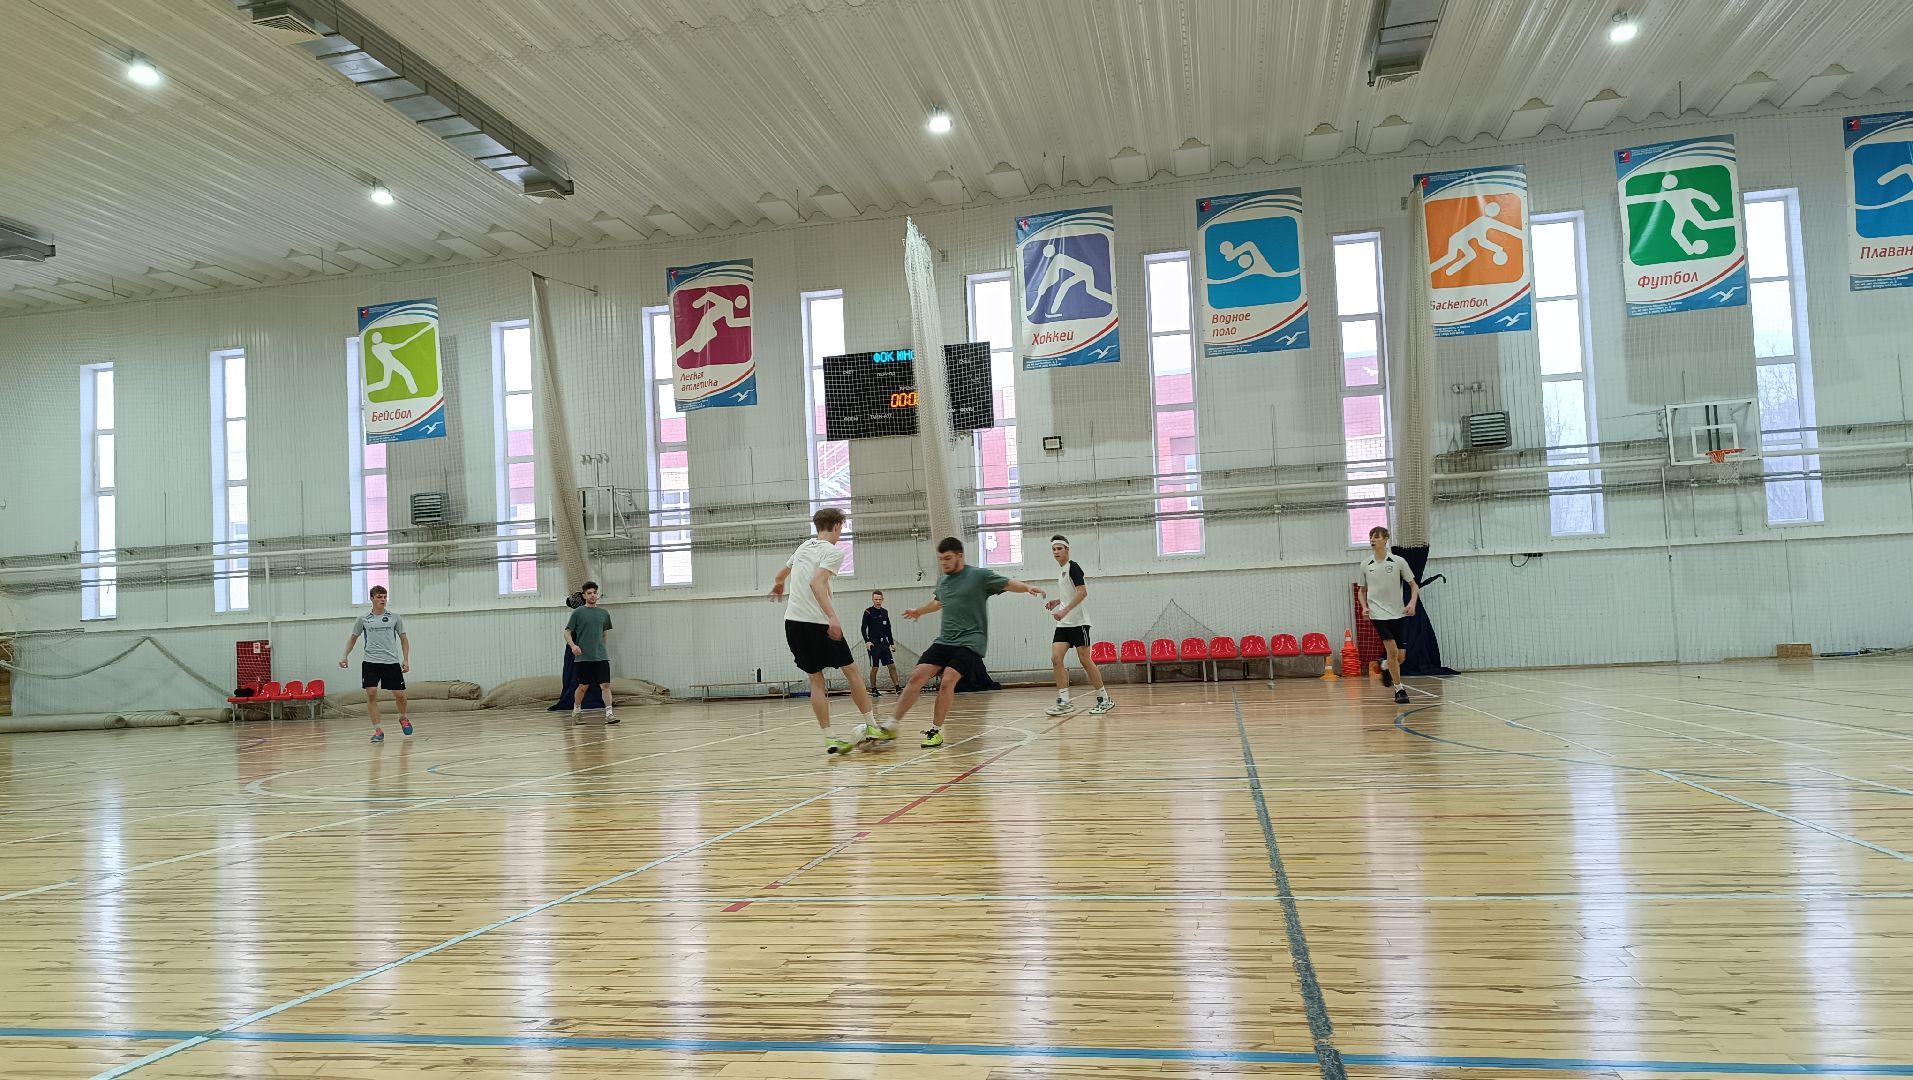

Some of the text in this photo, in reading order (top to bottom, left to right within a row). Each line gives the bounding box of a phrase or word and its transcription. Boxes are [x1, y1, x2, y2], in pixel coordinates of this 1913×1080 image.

[1638, 271, 1698, 289] Футбол
[1212, 313, 1251, 324] Водное
[1032, 330, 1074, 345] Хоккей
[1212, 327, 1237, 337] поло
[873, 352, 895, 363] ФОК
[681, 379, 719, 391] атлетика
[372, 408, 412, 422] Бейсбол
